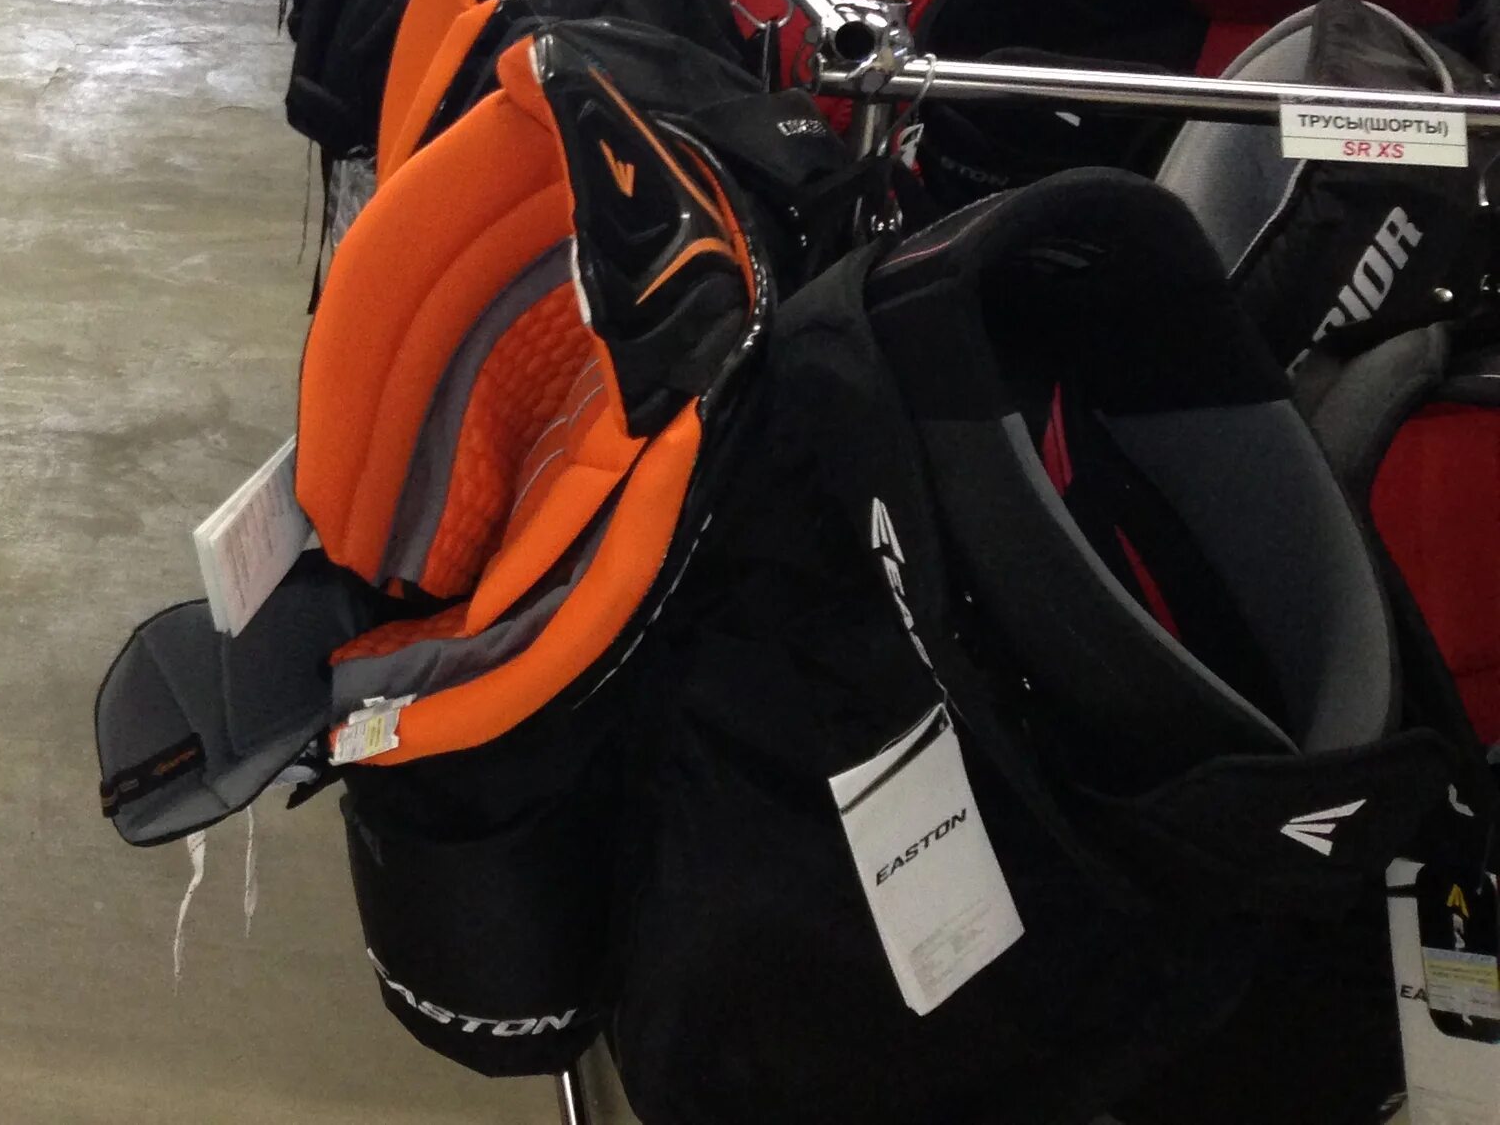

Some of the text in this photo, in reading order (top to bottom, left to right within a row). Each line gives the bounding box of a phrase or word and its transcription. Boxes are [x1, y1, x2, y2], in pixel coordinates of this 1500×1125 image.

[1297, 113, 1449, 138] ТРУСЫ(ШОРТЫ)
[1342, 141, 1405, 159] SR XS
[875, 808, 968, 888] EASTON
